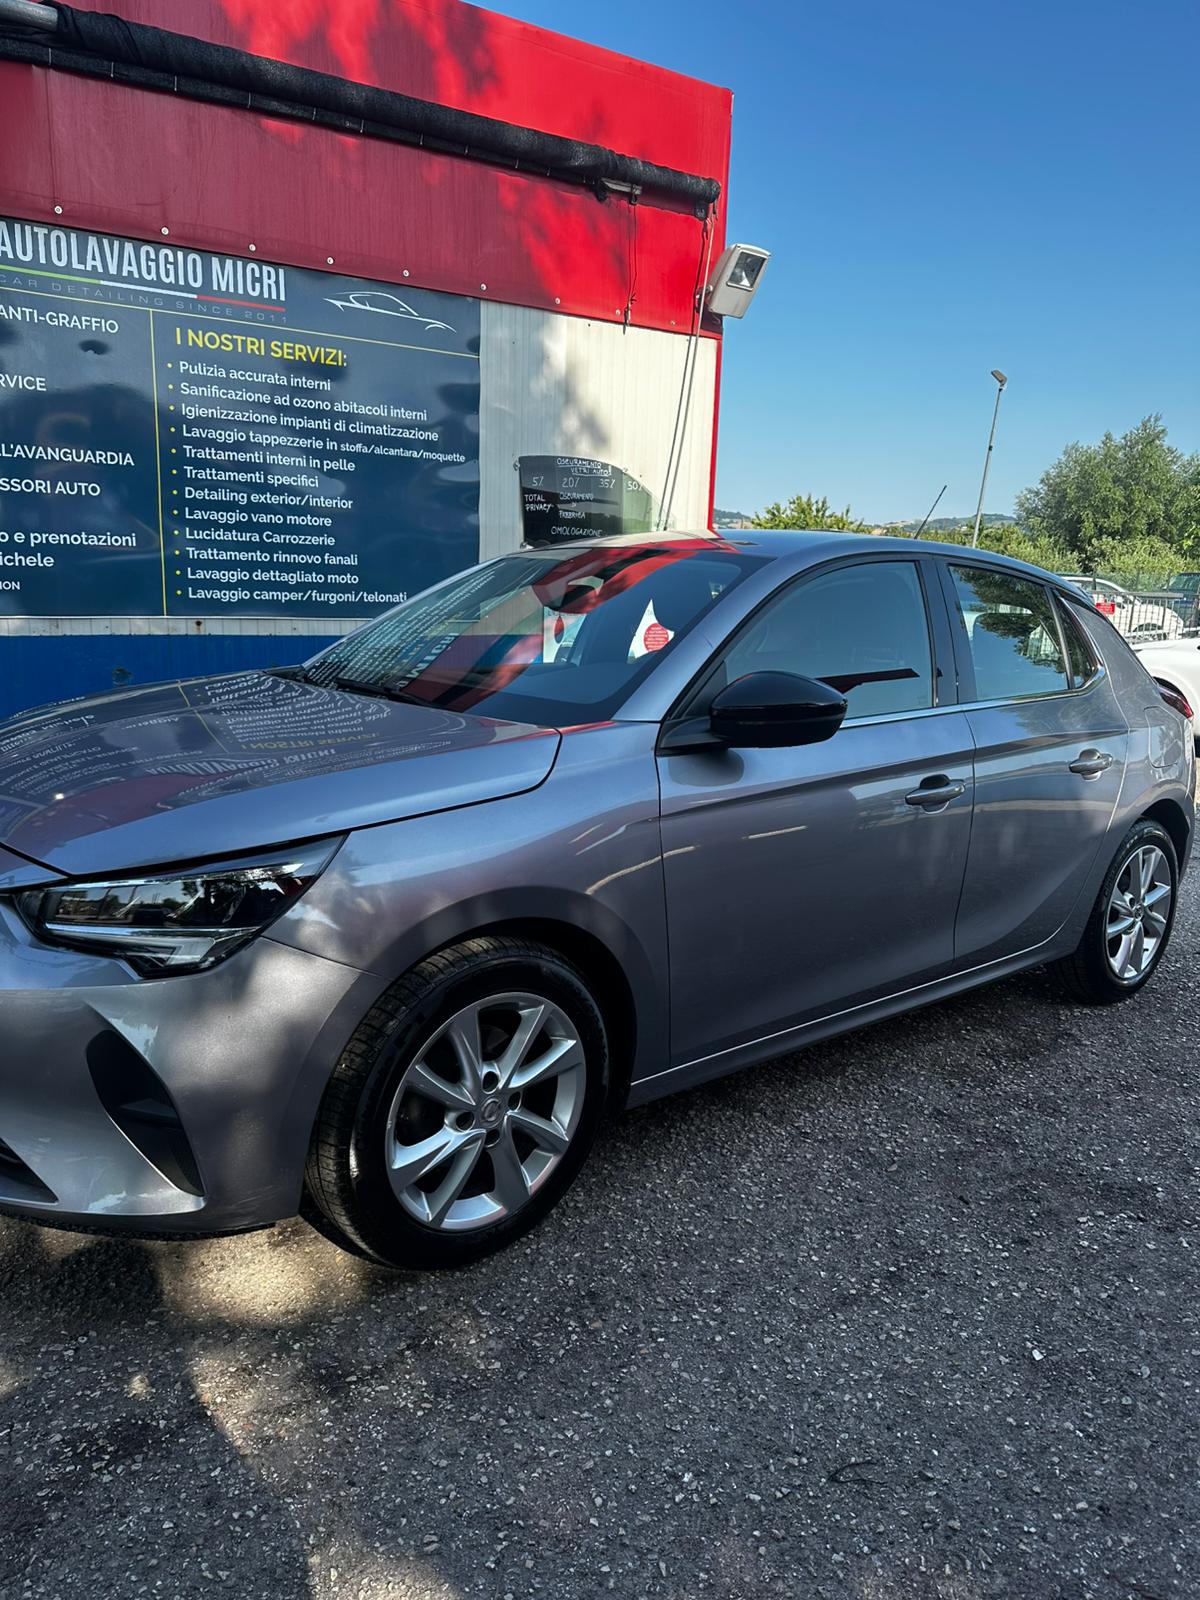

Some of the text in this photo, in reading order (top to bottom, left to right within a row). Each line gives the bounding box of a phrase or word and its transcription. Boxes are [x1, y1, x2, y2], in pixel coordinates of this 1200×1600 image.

[0, 220, 285, 301] AUTOLAVAGGIO MICRI
[50, 283, 164, 306] DETAILING
[175, 300, 234, 318] SINCE
[243, 309, 288, 325] 2011
[0, 303, 120, 335] ANTI-GRAFFIO
[175, 327, 348, 367] I NOSTRI SERVIZI:
[179, 361, 331, 391] Pulizia accurata interni
[180, 383, 427, 422] Sanificazione ad ozono abitacoli interni
[181, 403, 439, 442] Igienizzazione impianti di climatizzazione
[182, 424, 466, 464] Lavaggio tappezzerie in stoffa/alcantara/moquette
[183, 445, 356, 475] Trattamenti interni in pelle
[556, 458, 602, 468] OSCURAMENTO
[570, 466, 590, 475] VETRI
[184, 465, 319, 489] Trattamenti specifici
[55, 481, 101, 496] AUTO
[185, 486, 354, 511] Detailing exterior/interior
[524, 494, 545, 502] TOTAL
[185, 507, 333, 528] Lavaggio vano motore
[525, 503, 554, 513] PRIVACY
[14, 532, 25, 543] e
[30, 531, 137, 547] prenotazioni
[185, 527, 336, 547] Lucidatura Carrozzerie
[551, 526, 602, 537] OMOLOGAZIONE
[186, 547, 358, 567] Trattamento rinnovo fanali
[187, 566, 360, 585] Lavaggio dettagliato moto
[188, 587, 408, 604] Lavaggio camper/furgoni/telonati
